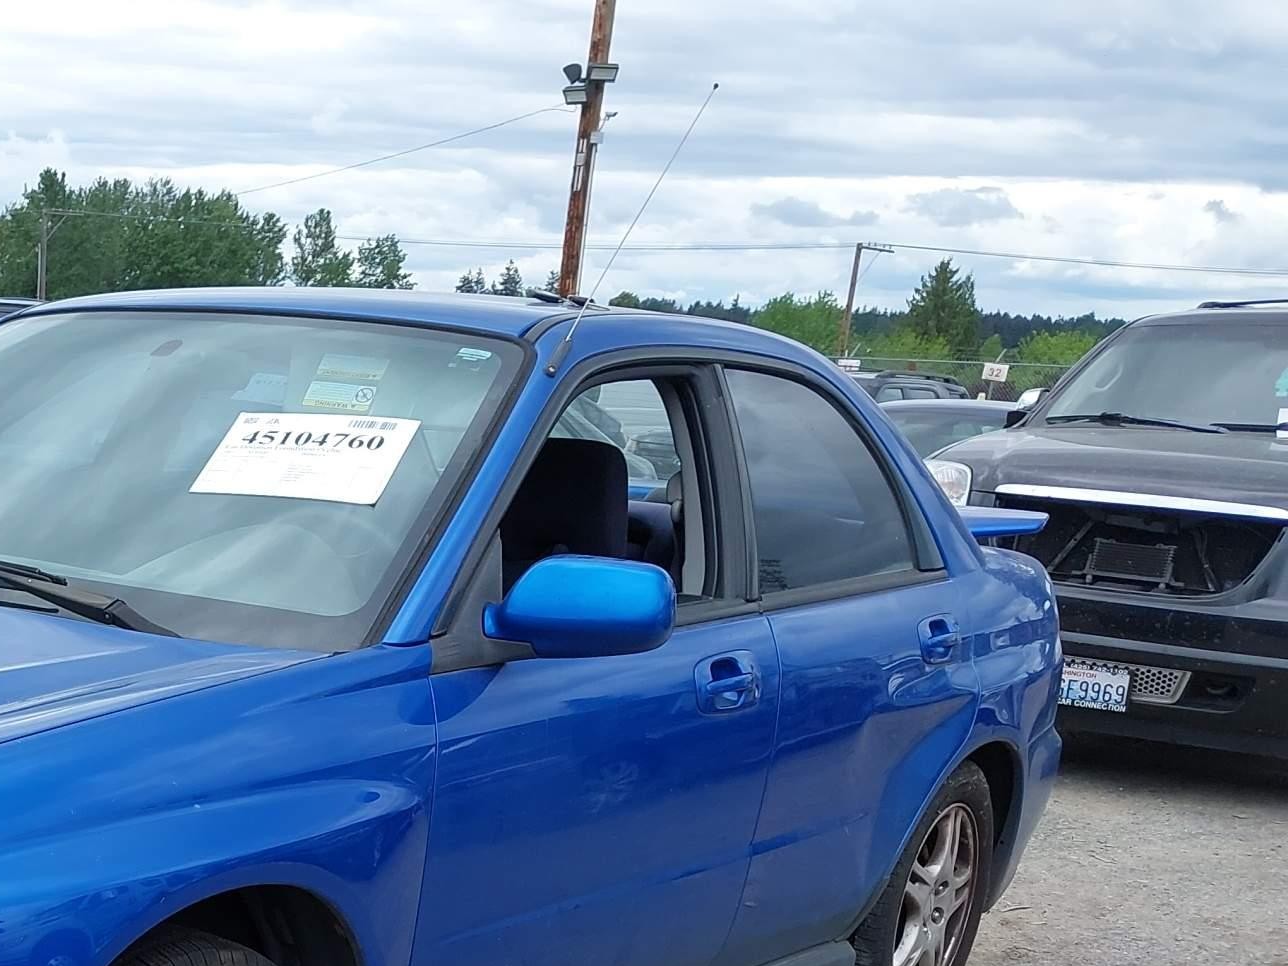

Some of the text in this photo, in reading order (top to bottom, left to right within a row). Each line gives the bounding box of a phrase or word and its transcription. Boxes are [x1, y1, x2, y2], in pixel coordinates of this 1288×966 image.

[988, 368, 1002, 377] 32
[242, 430, 385, 451] 45104760
[1074, 699, 1126, 713] CONNECTION
